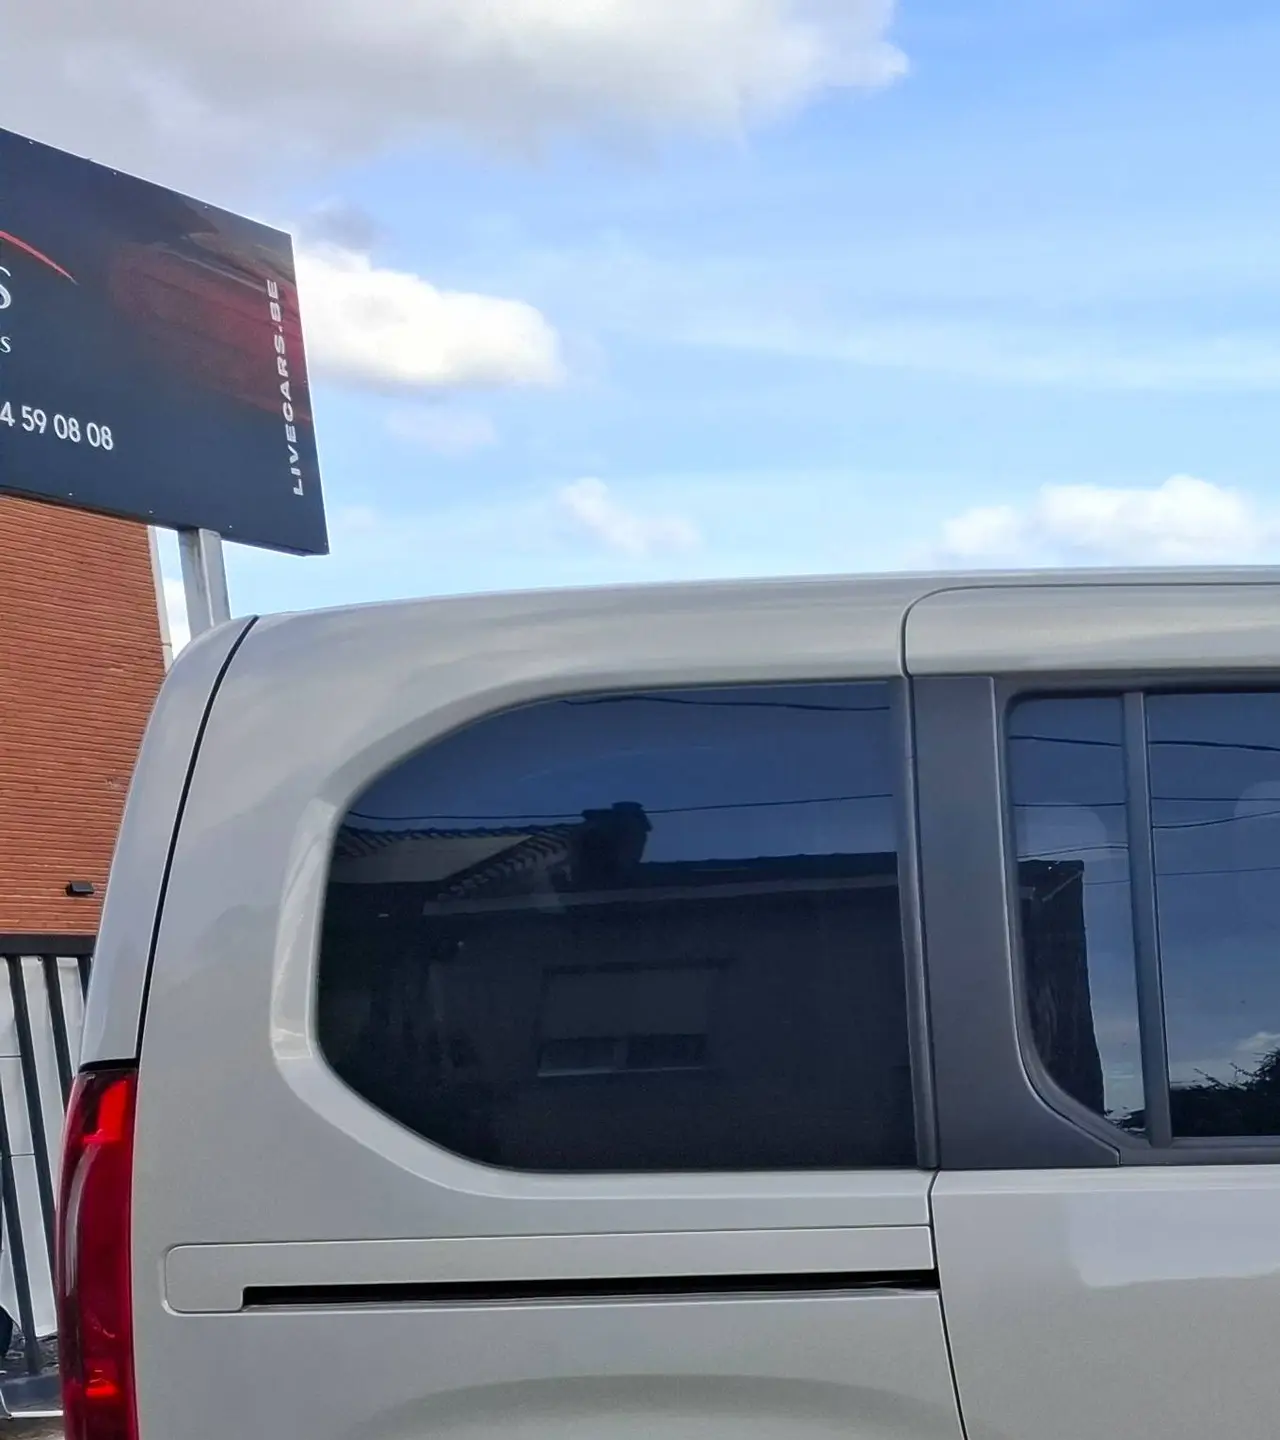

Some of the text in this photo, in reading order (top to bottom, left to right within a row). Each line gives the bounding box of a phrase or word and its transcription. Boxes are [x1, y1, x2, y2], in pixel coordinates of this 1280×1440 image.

[21, 405, 47, 434] 59
[53, 413, 81, 443] 08
[86, 422, 114, 451] 08
[266, 278, 304, 496] LIVECARS.BE
